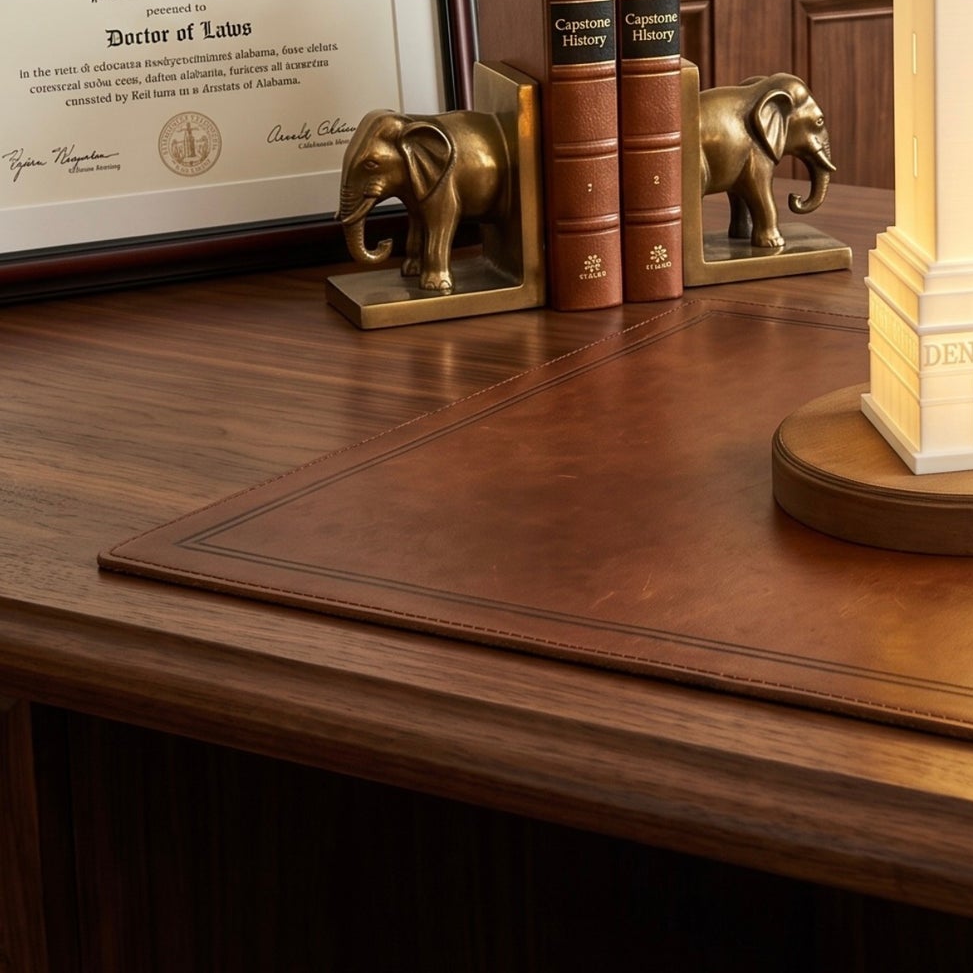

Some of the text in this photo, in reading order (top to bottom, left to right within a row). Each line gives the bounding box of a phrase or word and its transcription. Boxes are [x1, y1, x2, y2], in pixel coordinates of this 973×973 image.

[194, 3, 208, 13] to
[554, 17, 612, 34] Capstone
[624, 12, 679, 29] Capstone
[105, 20, 253, 48] Doctor of Laws
[562, 33, 608, 49] History
[33, 67, 51, 78] the
